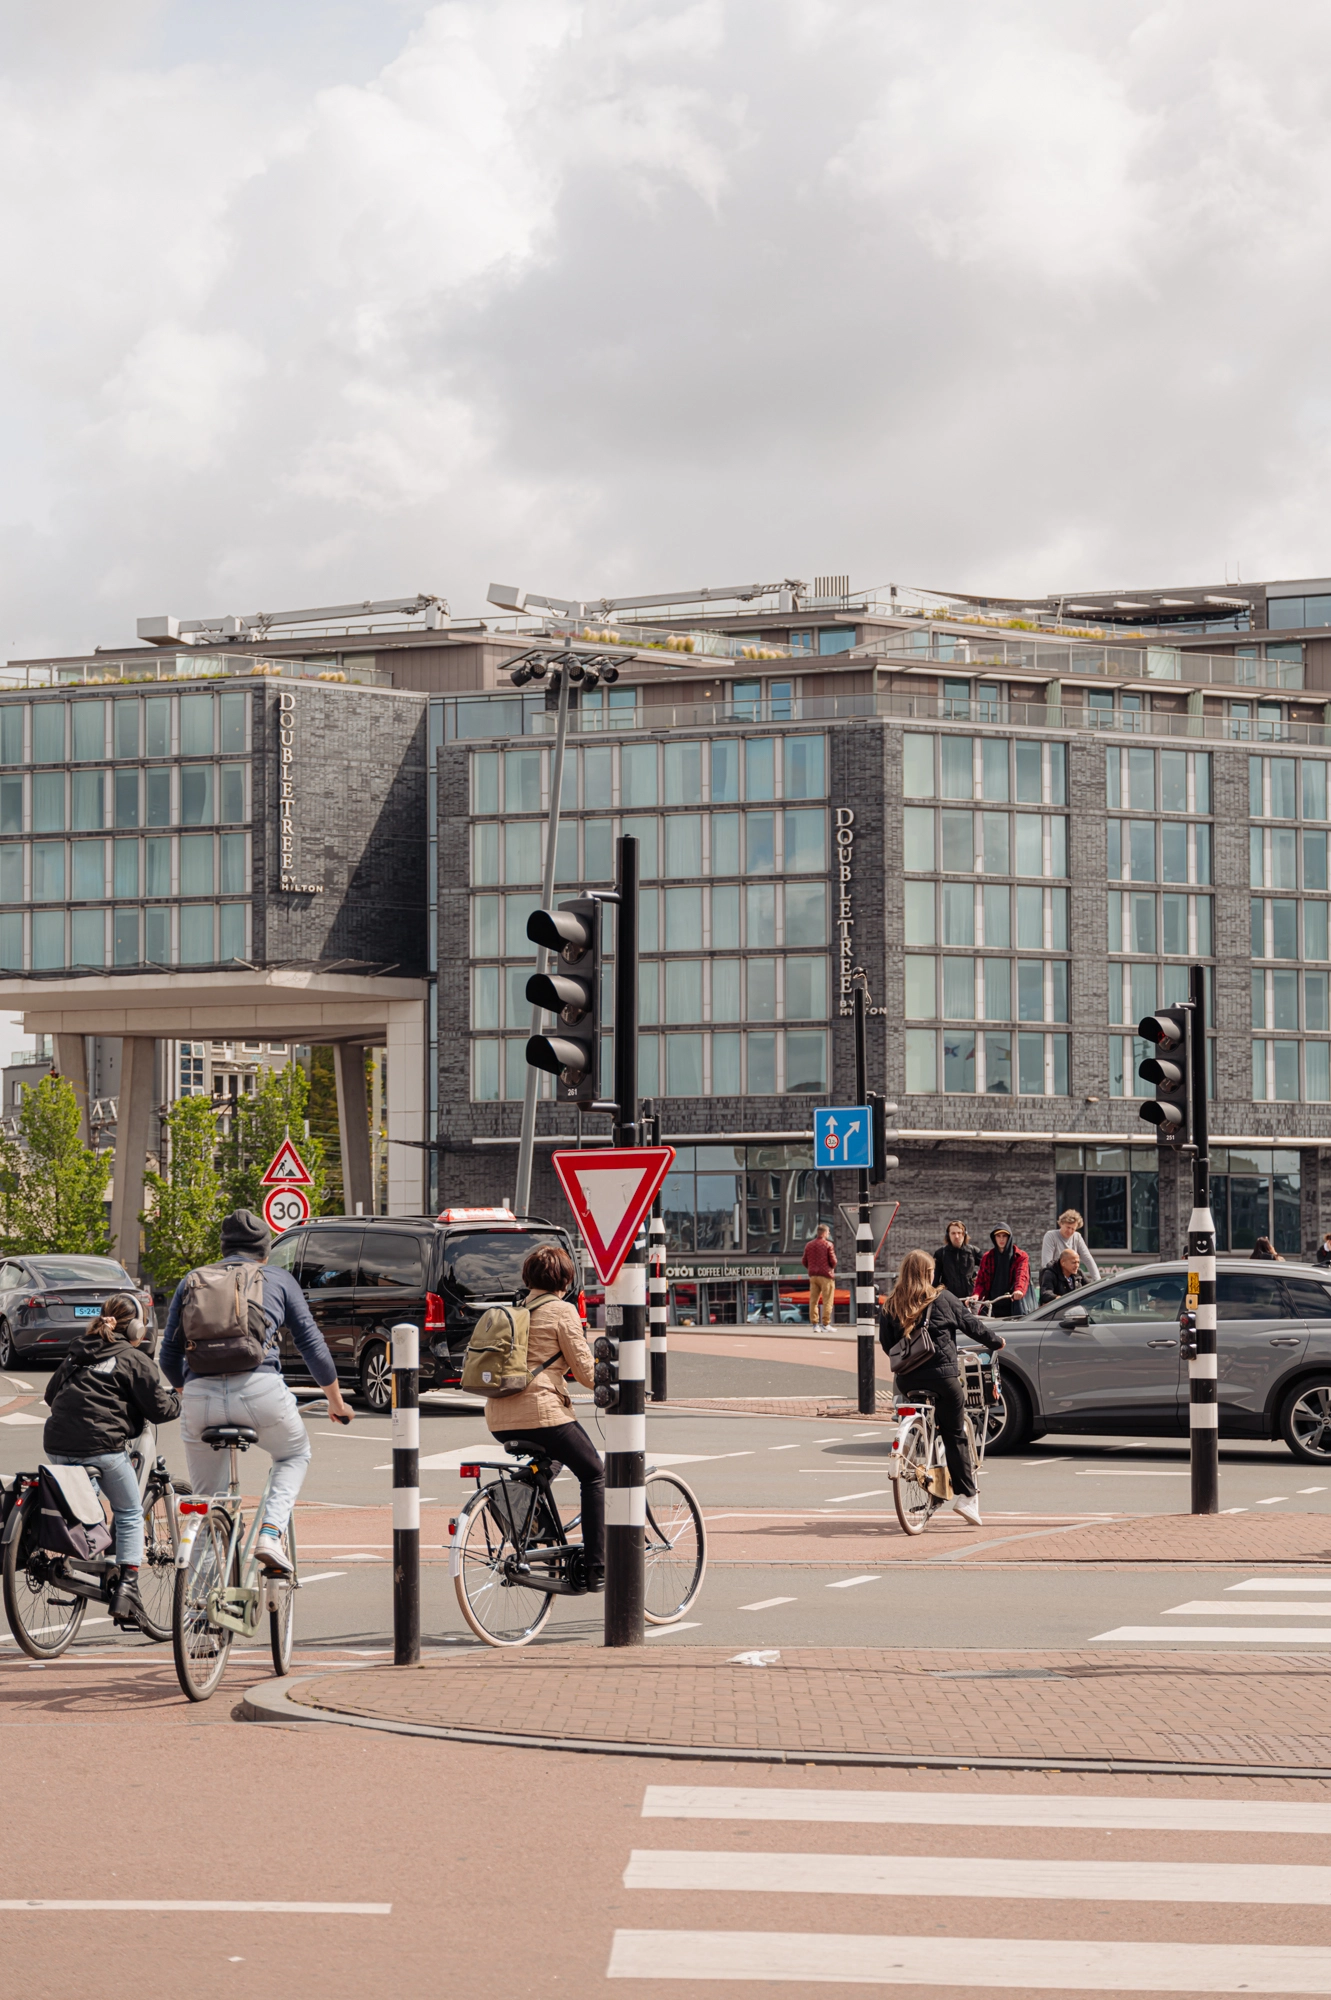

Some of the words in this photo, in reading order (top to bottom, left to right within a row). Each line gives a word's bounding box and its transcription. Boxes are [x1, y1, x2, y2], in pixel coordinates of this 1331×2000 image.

[279, 692, 296, 869] DOUBLETREE
[281, 875, 297, 883] BY
[281, 883, 324, 892] HILTON
[835, 807, 854, 994] DOUBLETREE
[567, 1088, 578, 1096] 261
[272, 1201, 301, 1220] 30
[697, 1266, 720, 1277] COFFEE
[724, 1266, 741, 1276] CAKE
[744, 1266, 760, 1276] COLD
[761, 1266, 780, 1276] BREW
